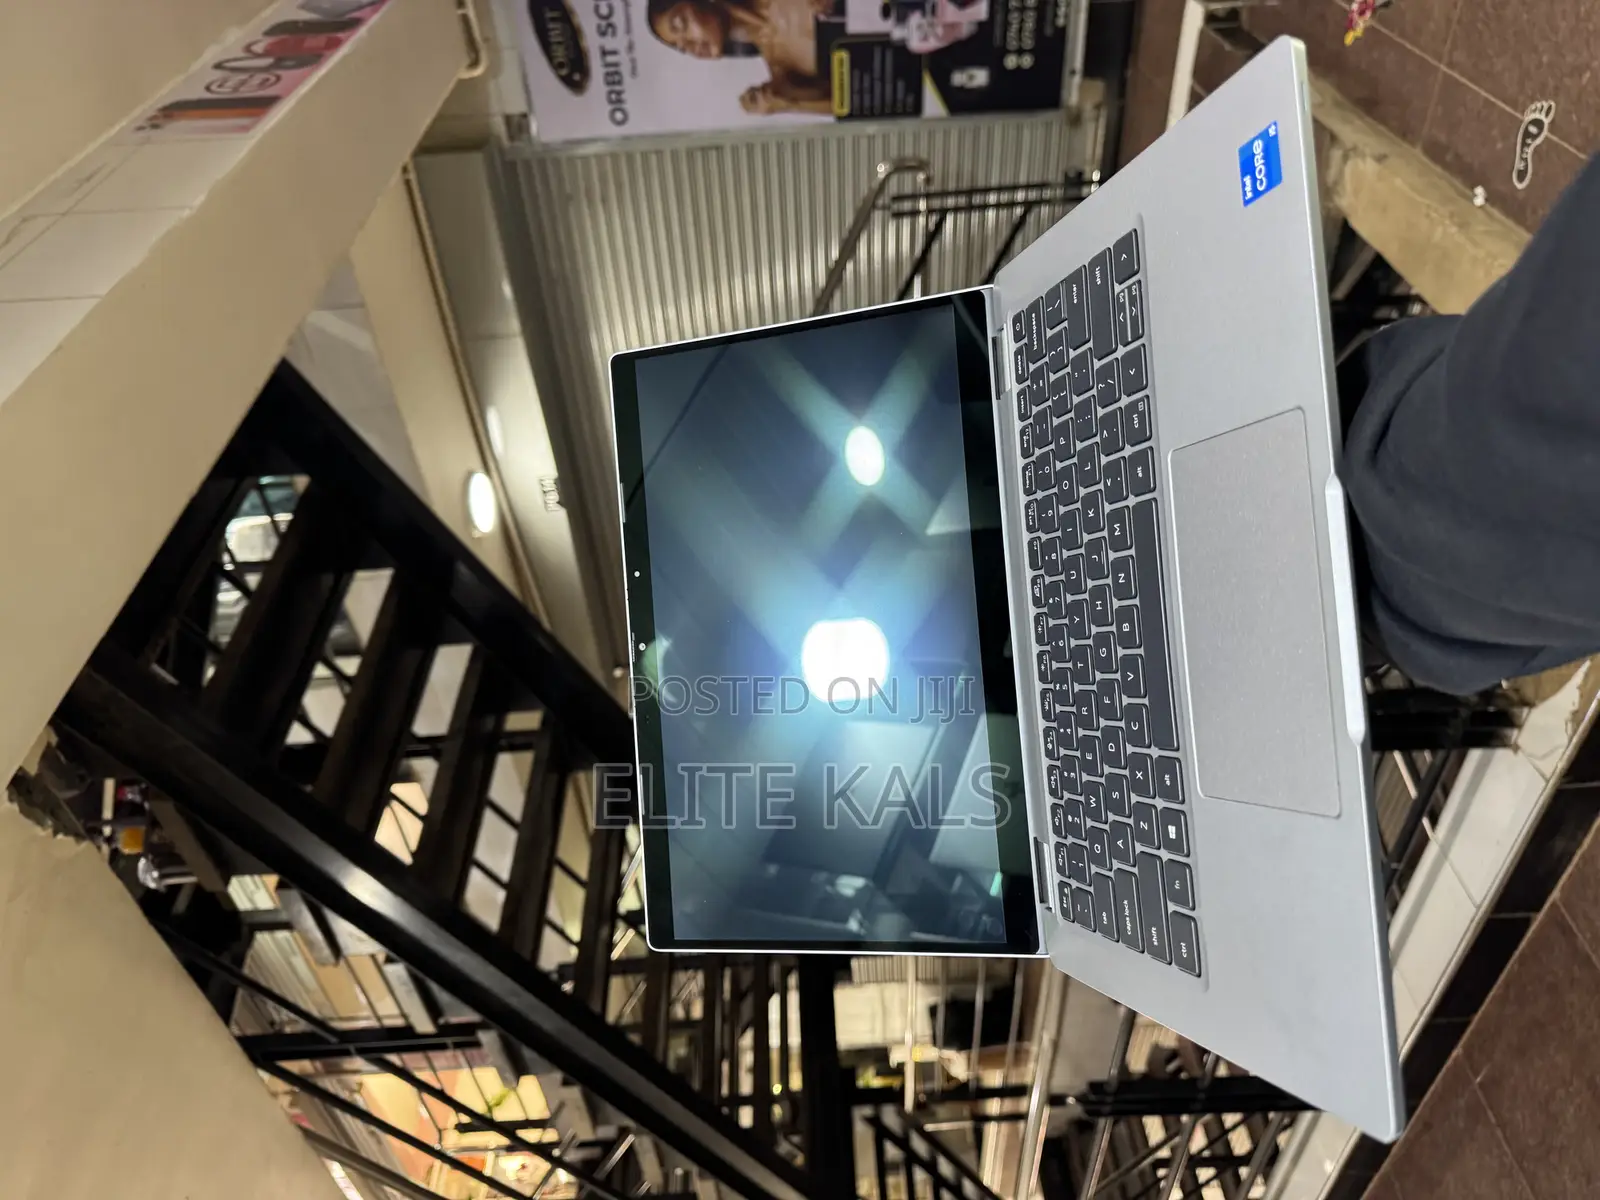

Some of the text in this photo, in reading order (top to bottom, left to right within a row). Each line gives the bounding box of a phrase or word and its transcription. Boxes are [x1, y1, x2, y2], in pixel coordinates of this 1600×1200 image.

[543, 6, 569, 76] ORBIT
[592, 0, 628, 127] ORBIT SC
[1243, 174, 1254, 200] intel
[1060, 437, 1066, 445] P
[1084, 462, 1091, 470] L
[1063, 480, 1069, 490] O
[1088, 508, 1094, 517] K
[1114, 523, 1121, 536] M
[1070, 570, 1076, 579] U
[1118, 573, 1125, 583] N
[1096, 601, 1102, 610] H
[1122, 623, 1130, 631] B
[1099, 648, 1107, 657] G
[1077, 661, 1084, 669] T
[1127, 672, 1134, 681] V
[1081, 707, 1088, 715] R
[1131, 722, 1139, 730] C
[1108, 743, 1115, 752] D
[1086, 752, 1092, 760] E
[1136, 771, 1143, 780] X
[1112, 791, 1119, 799] S
[1089, 795, 1096, 807] W
[1140, 821, 1148, 830] Z
[1117, 839, 1124, 849] A
[1094, 844, 1101, 854] Q
[1174, 880, 1180, 889] fn
